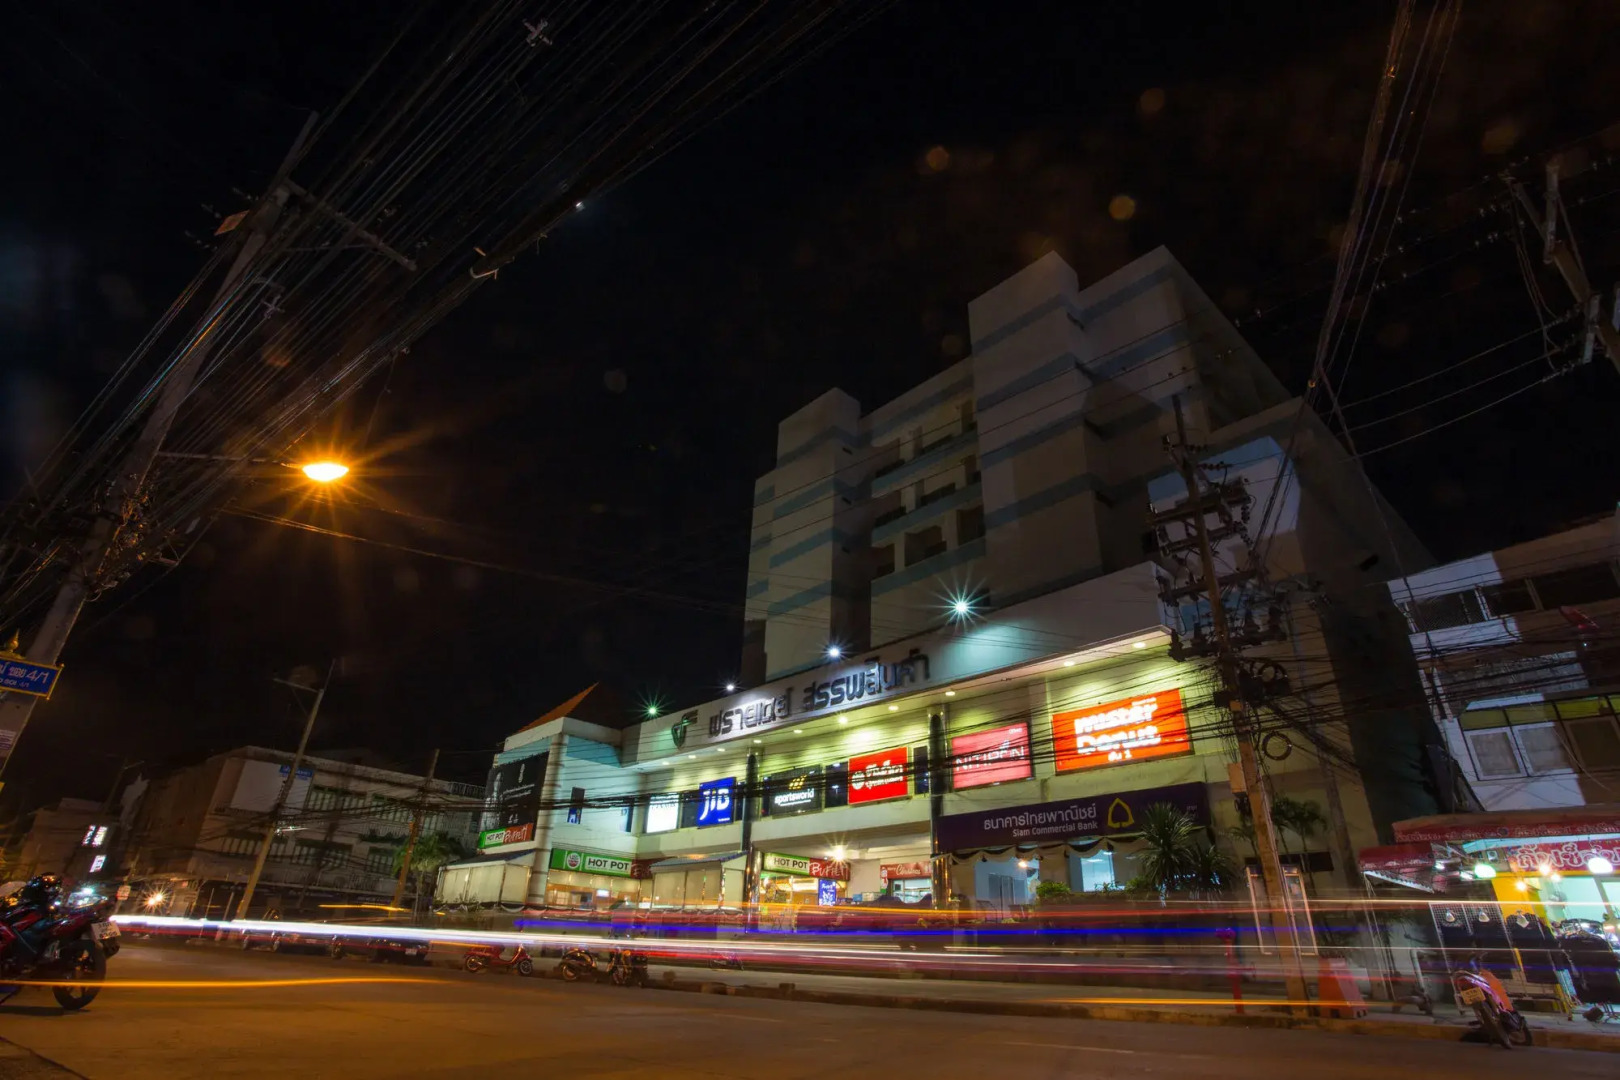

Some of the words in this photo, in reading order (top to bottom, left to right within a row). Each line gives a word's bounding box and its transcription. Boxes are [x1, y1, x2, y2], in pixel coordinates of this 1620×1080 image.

[25, 670, 49, 684] 4/1
[774, 788, 815, 805] sportsworld
[984, 803, 1097, 830] ธนาคารไทยพาณิชย์
[1012, 828, 1030, 837] Siam
[1031, 823, 1076, 835] Commercial
[1077, 821, 1098, 831] Bank
[486, 833, 495, 842] HOT
[495, 832, 504, 841] POT
[587, 857, 607, 868] HOT
[610, 860, 629, 871] POT
[774, 857, 790, 867] HOT
[792, 860, 808, 869] POT
